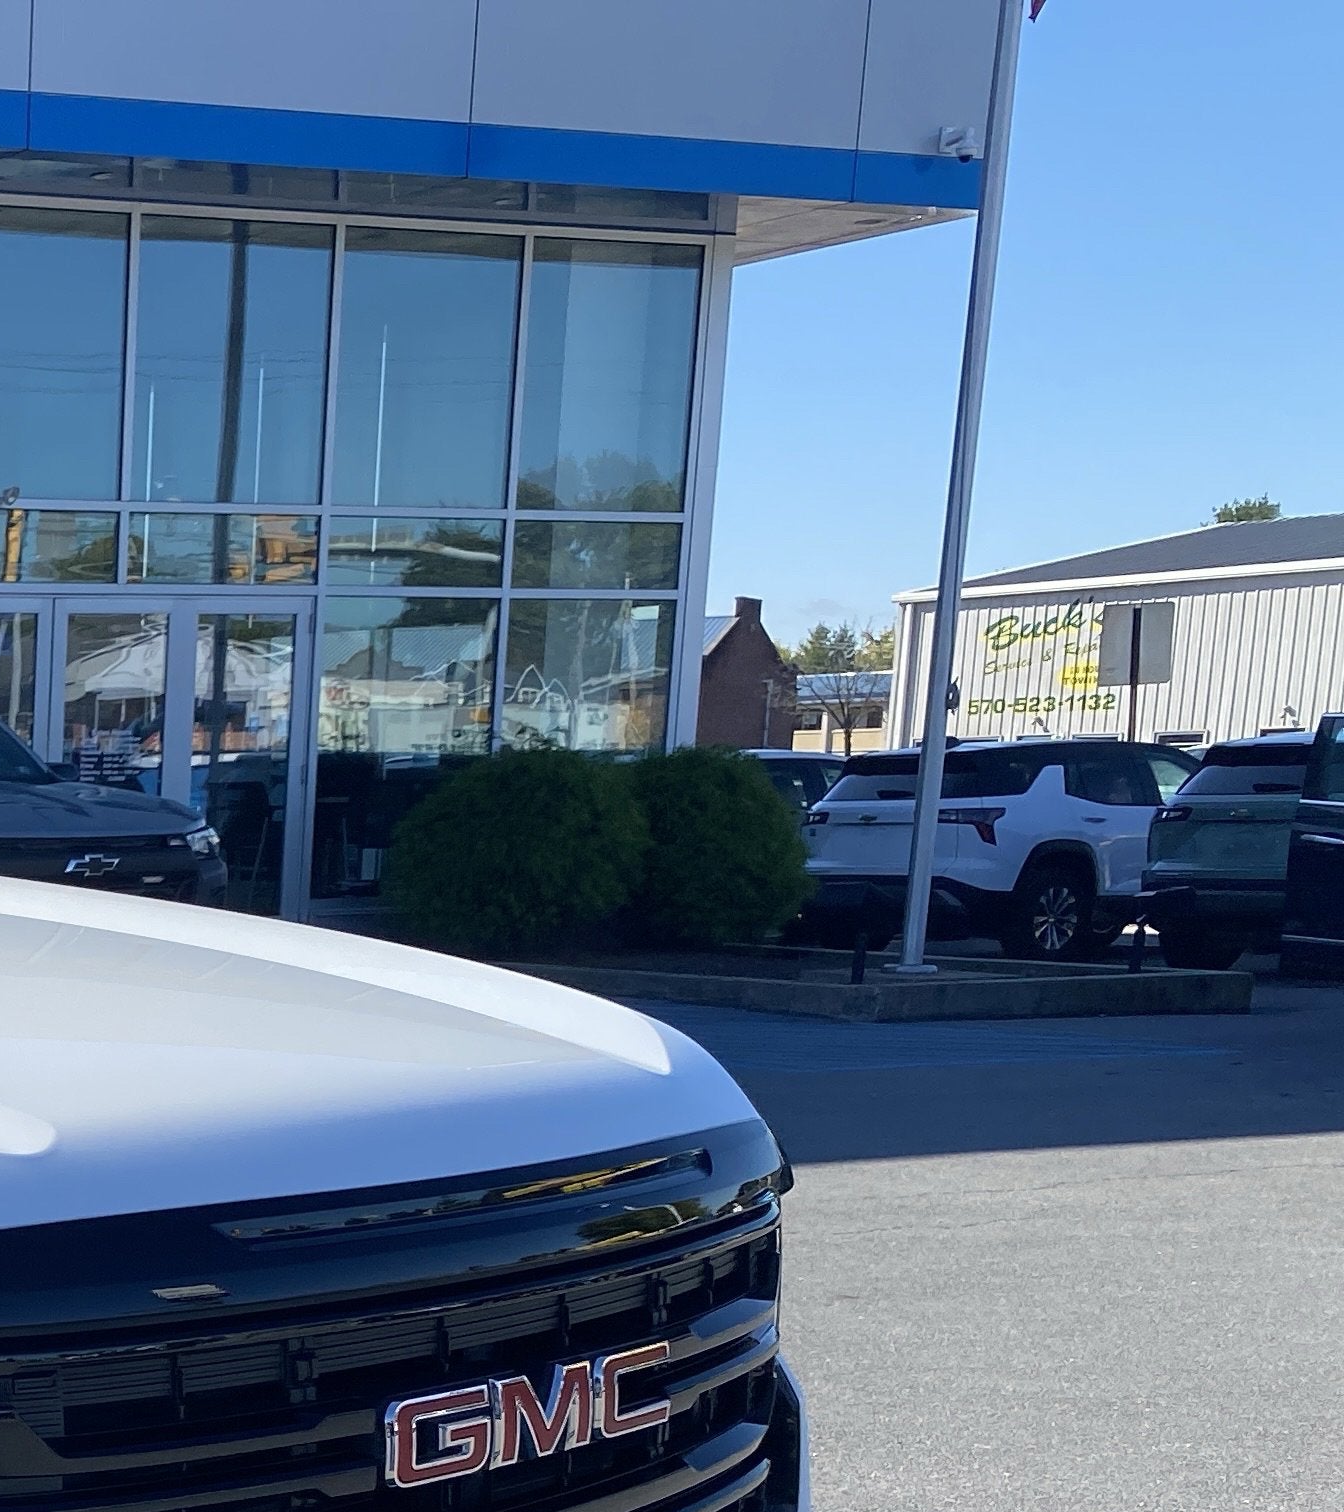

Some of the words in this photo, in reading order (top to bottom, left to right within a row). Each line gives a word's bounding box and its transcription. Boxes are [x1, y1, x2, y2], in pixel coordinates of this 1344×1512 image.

[1041, 648, 1052, 662] &
[1064, 642, 1098, 656] Repa
[967, 693, 1116, 715] 570-523-1132
[385, 1340, 671, 1488] GMC
